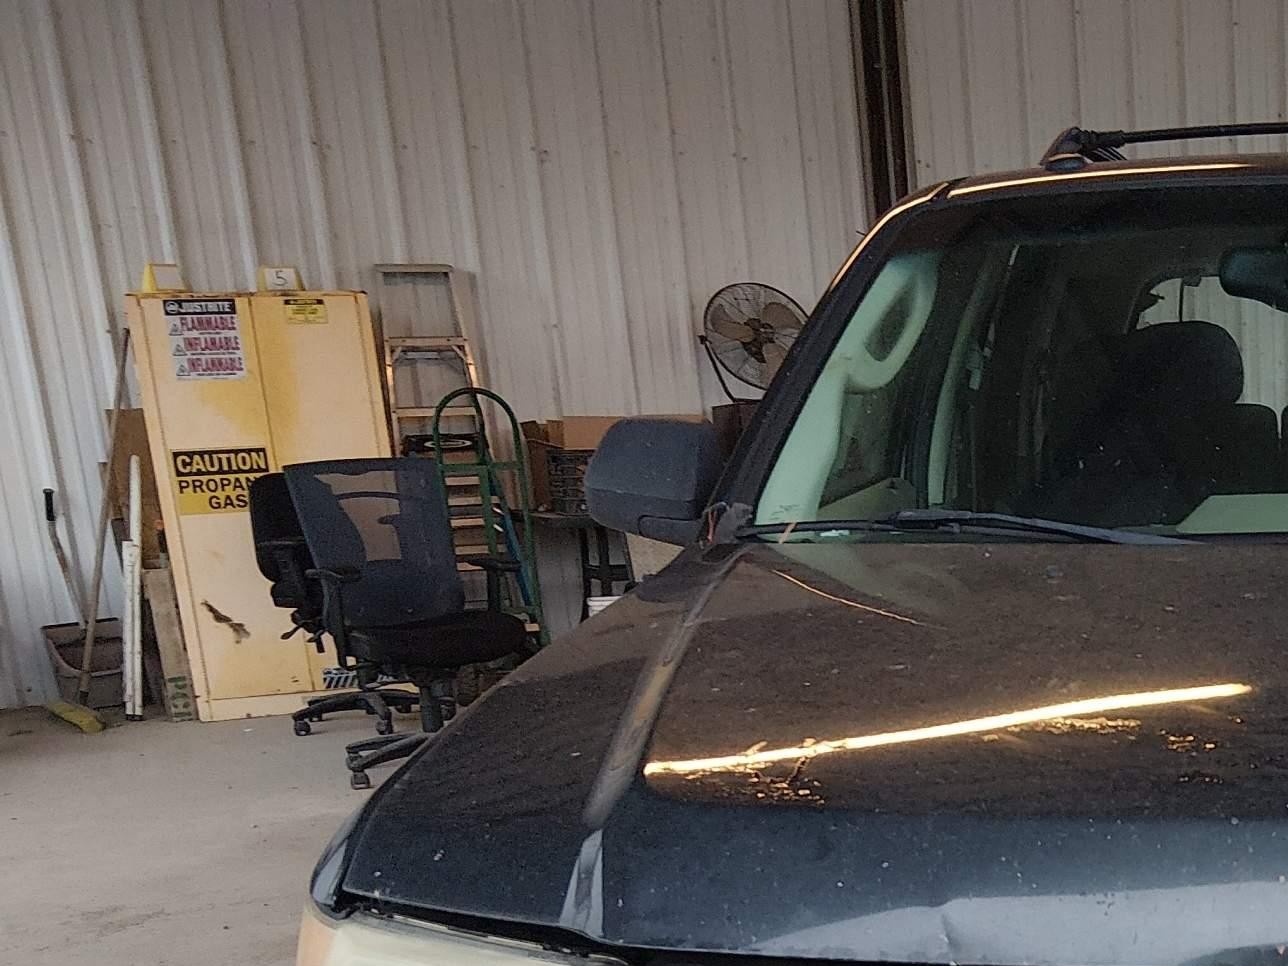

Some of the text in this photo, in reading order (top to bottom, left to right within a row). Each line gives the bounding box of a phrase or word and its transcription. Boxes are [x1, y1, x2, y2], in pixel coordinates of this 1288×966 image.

[272, 270, 288, 286] 5
[180, 316, 236, 331] FLAMMABLE
[176, 452, 266, 473] CAUTION
[178, 477, 257, 494] PROPAN
[208, 494, 248, 509] GAS
